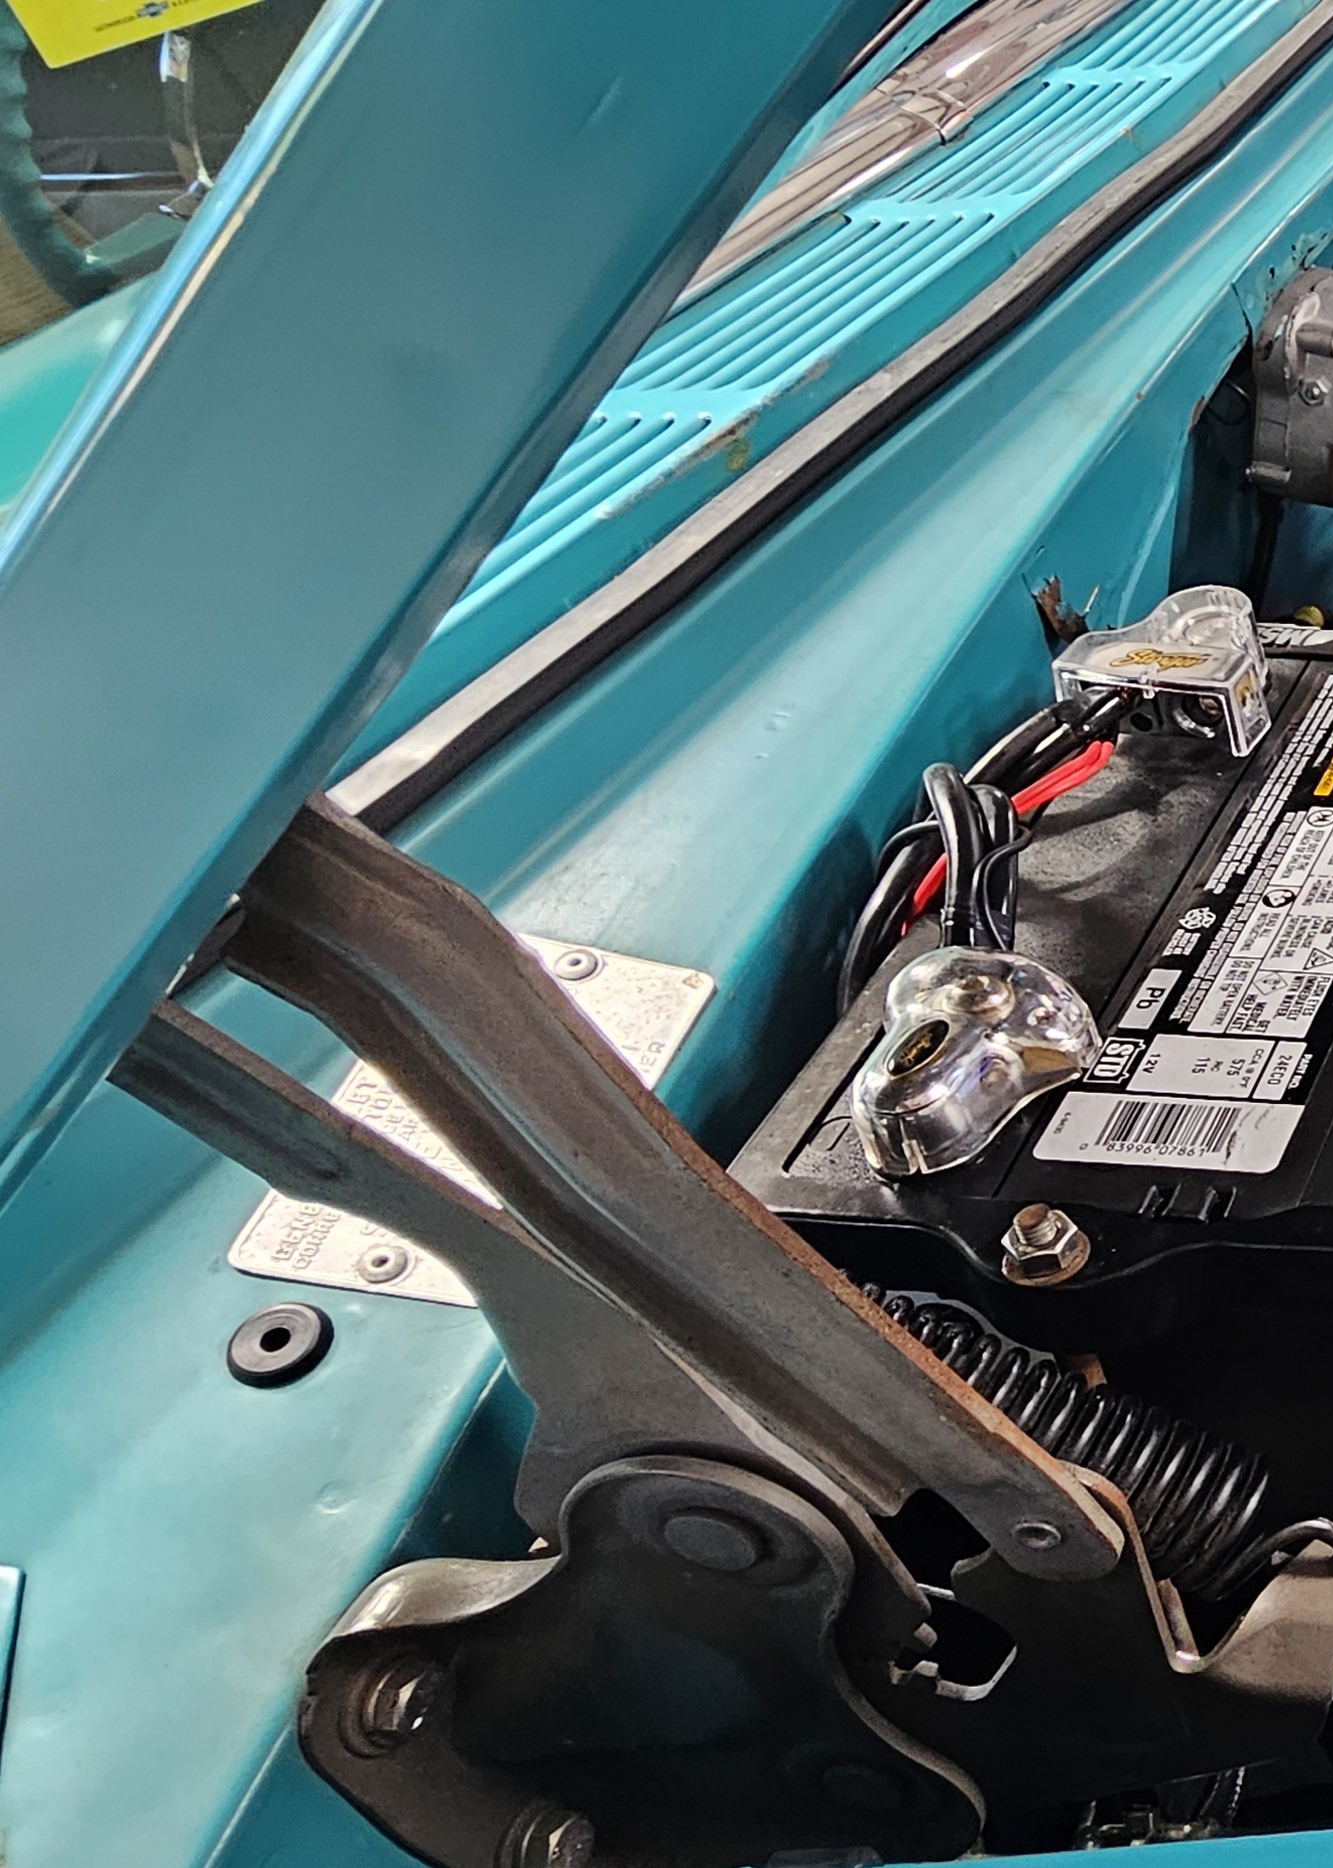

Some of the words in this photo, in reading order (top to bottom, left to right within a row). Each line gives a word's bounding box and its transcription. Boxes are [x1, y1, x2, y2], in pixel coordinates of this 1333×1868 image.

[1285, 975, 1305, 994] WITH
[1136, 986, 1166, 1010] Pb
[1239, 993, 1259, 1011] HELP
[1271, 994, 1295, 1020] WATER.
[1285, 975, 1318, 1021] IMMEDIATELY
[1300, 998, 1320, 1017] EYES
[1228, 1012, 1249, 1031] FAST.
[1240, 1001, 1267, 1033] MEDICAL
[1093, 1042, 1134, 1077] STD
[1141, 1052, 1161, 1073] 12V
[1190, 1056, 1211, 1074] 115
[1226, 1057, 1246, 1076] 575
[1249, 1048, 1264, 1066] CCA
[1294, 1053, 1313, 1073] PART
[1287, 1074, 1303, 1090] NO.
[1106, 1141, 1151, 1155] 83996
